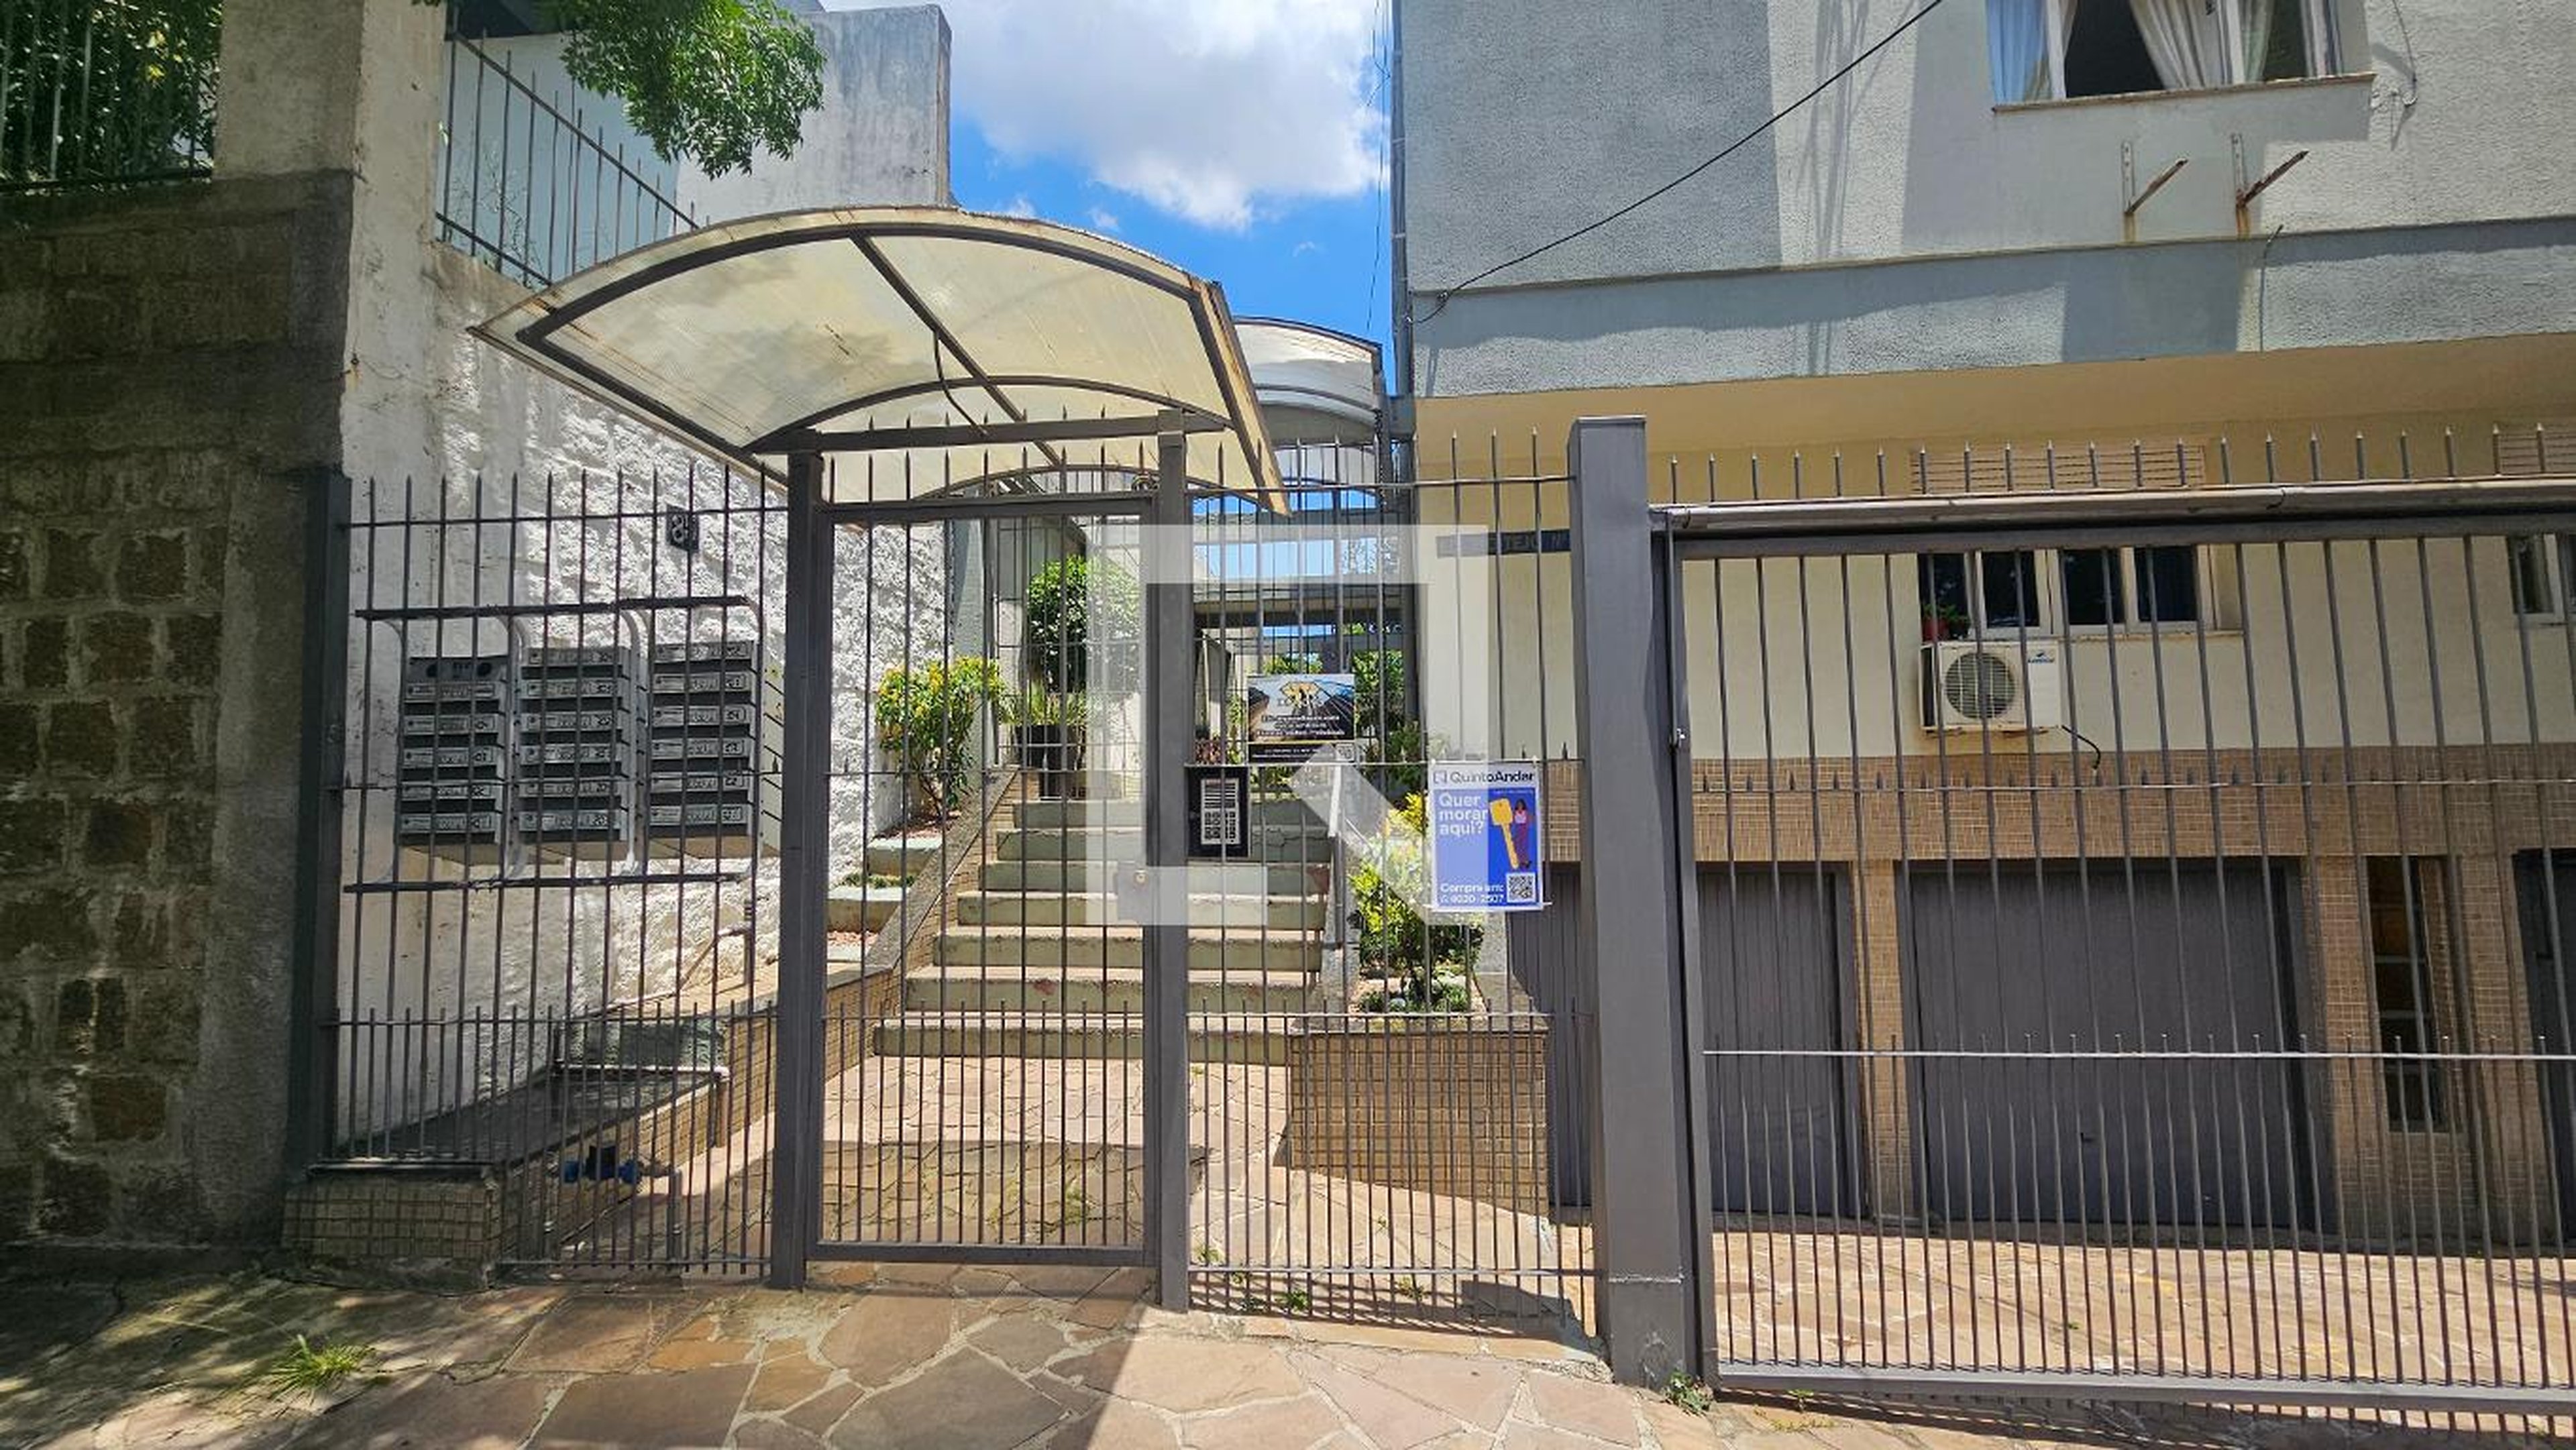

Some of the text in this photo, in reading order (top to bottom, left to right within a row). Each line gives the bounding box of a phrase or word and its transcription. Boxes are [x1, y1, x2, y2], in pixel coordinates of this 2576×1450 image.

[1450, 771, 1534, 783] QuintoAndar
[1439, 793, 1481, 807] Quer
[1439, 810, 1489, 821] morar
[1439, 820, 1484, 837] aqui?
